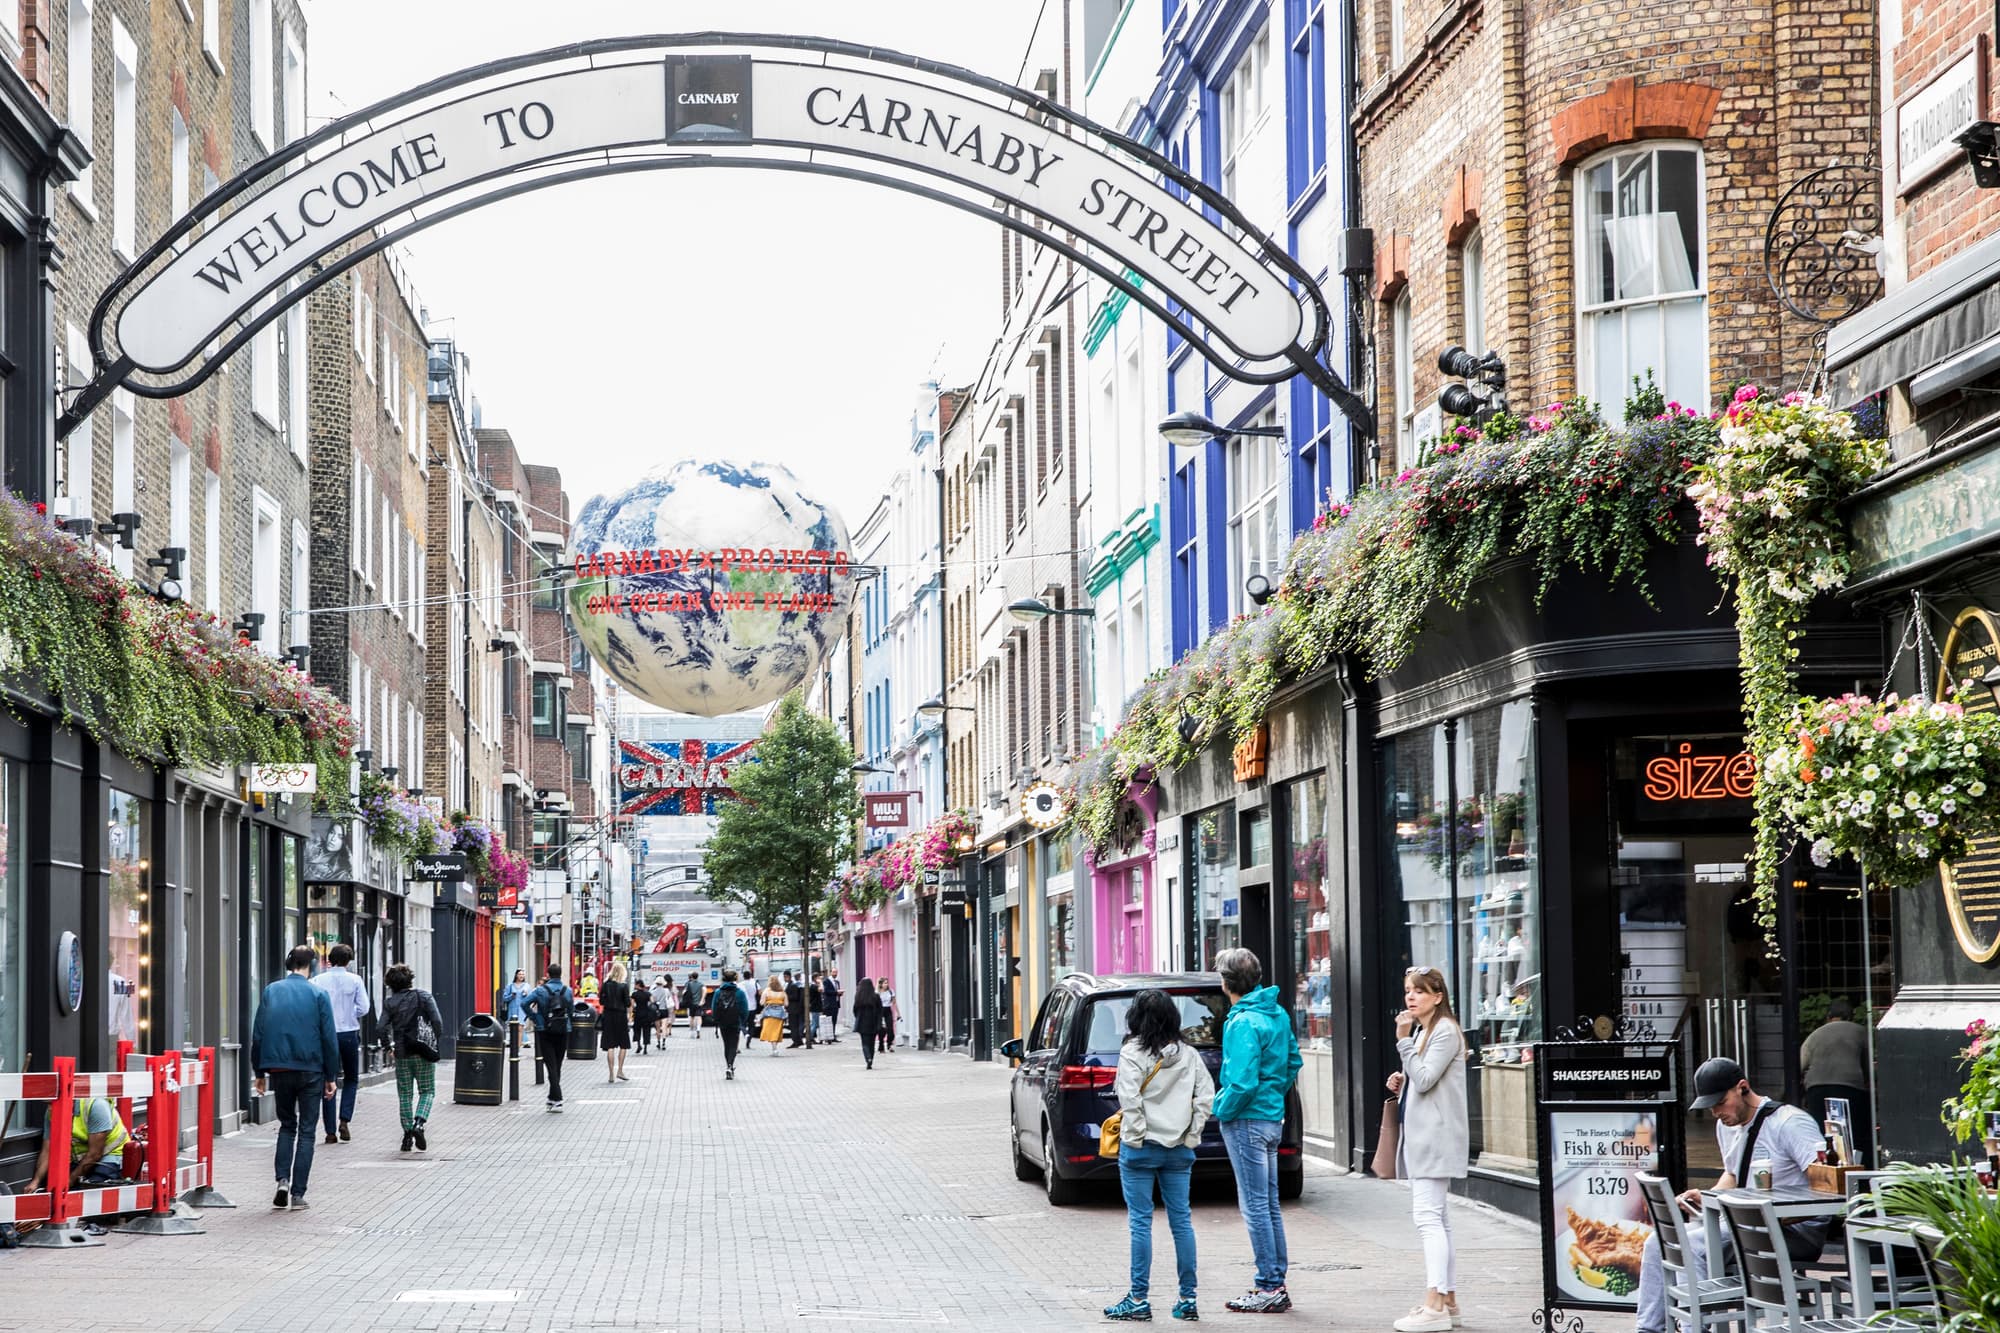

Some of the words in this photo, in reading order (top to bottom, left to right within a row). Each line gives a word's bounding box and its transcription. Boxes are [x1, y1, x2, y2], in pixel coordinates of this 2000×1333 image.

[678, 93, 739, 105] CARNABY
[194, 133, 447, 295] WELCOME
[483, 101, 555, 149] TO
[806, 87, 1063, 189] CARNABY
[1079, 178, 1259, 315] STREET
[575, 549, 694, 578] CARNABY
[720, 548, 848, 576] PROJECTS
[588, 595, 623, 615] ONE
[630, 591, 702, 613] OCEAN
[710, 592, 755, 612] ONE
[763, 592, 834, 613] PLANET
[620, 762, 745, 789] CARNA
[873, 802, 901, 816] MUJI
[415, 860, 434, 874] Pepe
[434, 861, 461, 874] Jeans
[735, 938, 758, 947] CAR
[761, 937, 786, 947] HRE
[1553, 1070, 1629, 1081] SHAKESPEARES
[1631, 1070, 1662, 1080] HEAD
[1611, 1129, 1636, 1138] Quality
[1564, 1141, 1592, 1155] Fish
[1597, 1142, 1607, 1155] &
[1611, 1141, 1650, 1160] Chips
[1587, 1177, 1629, 1196] 13.79
